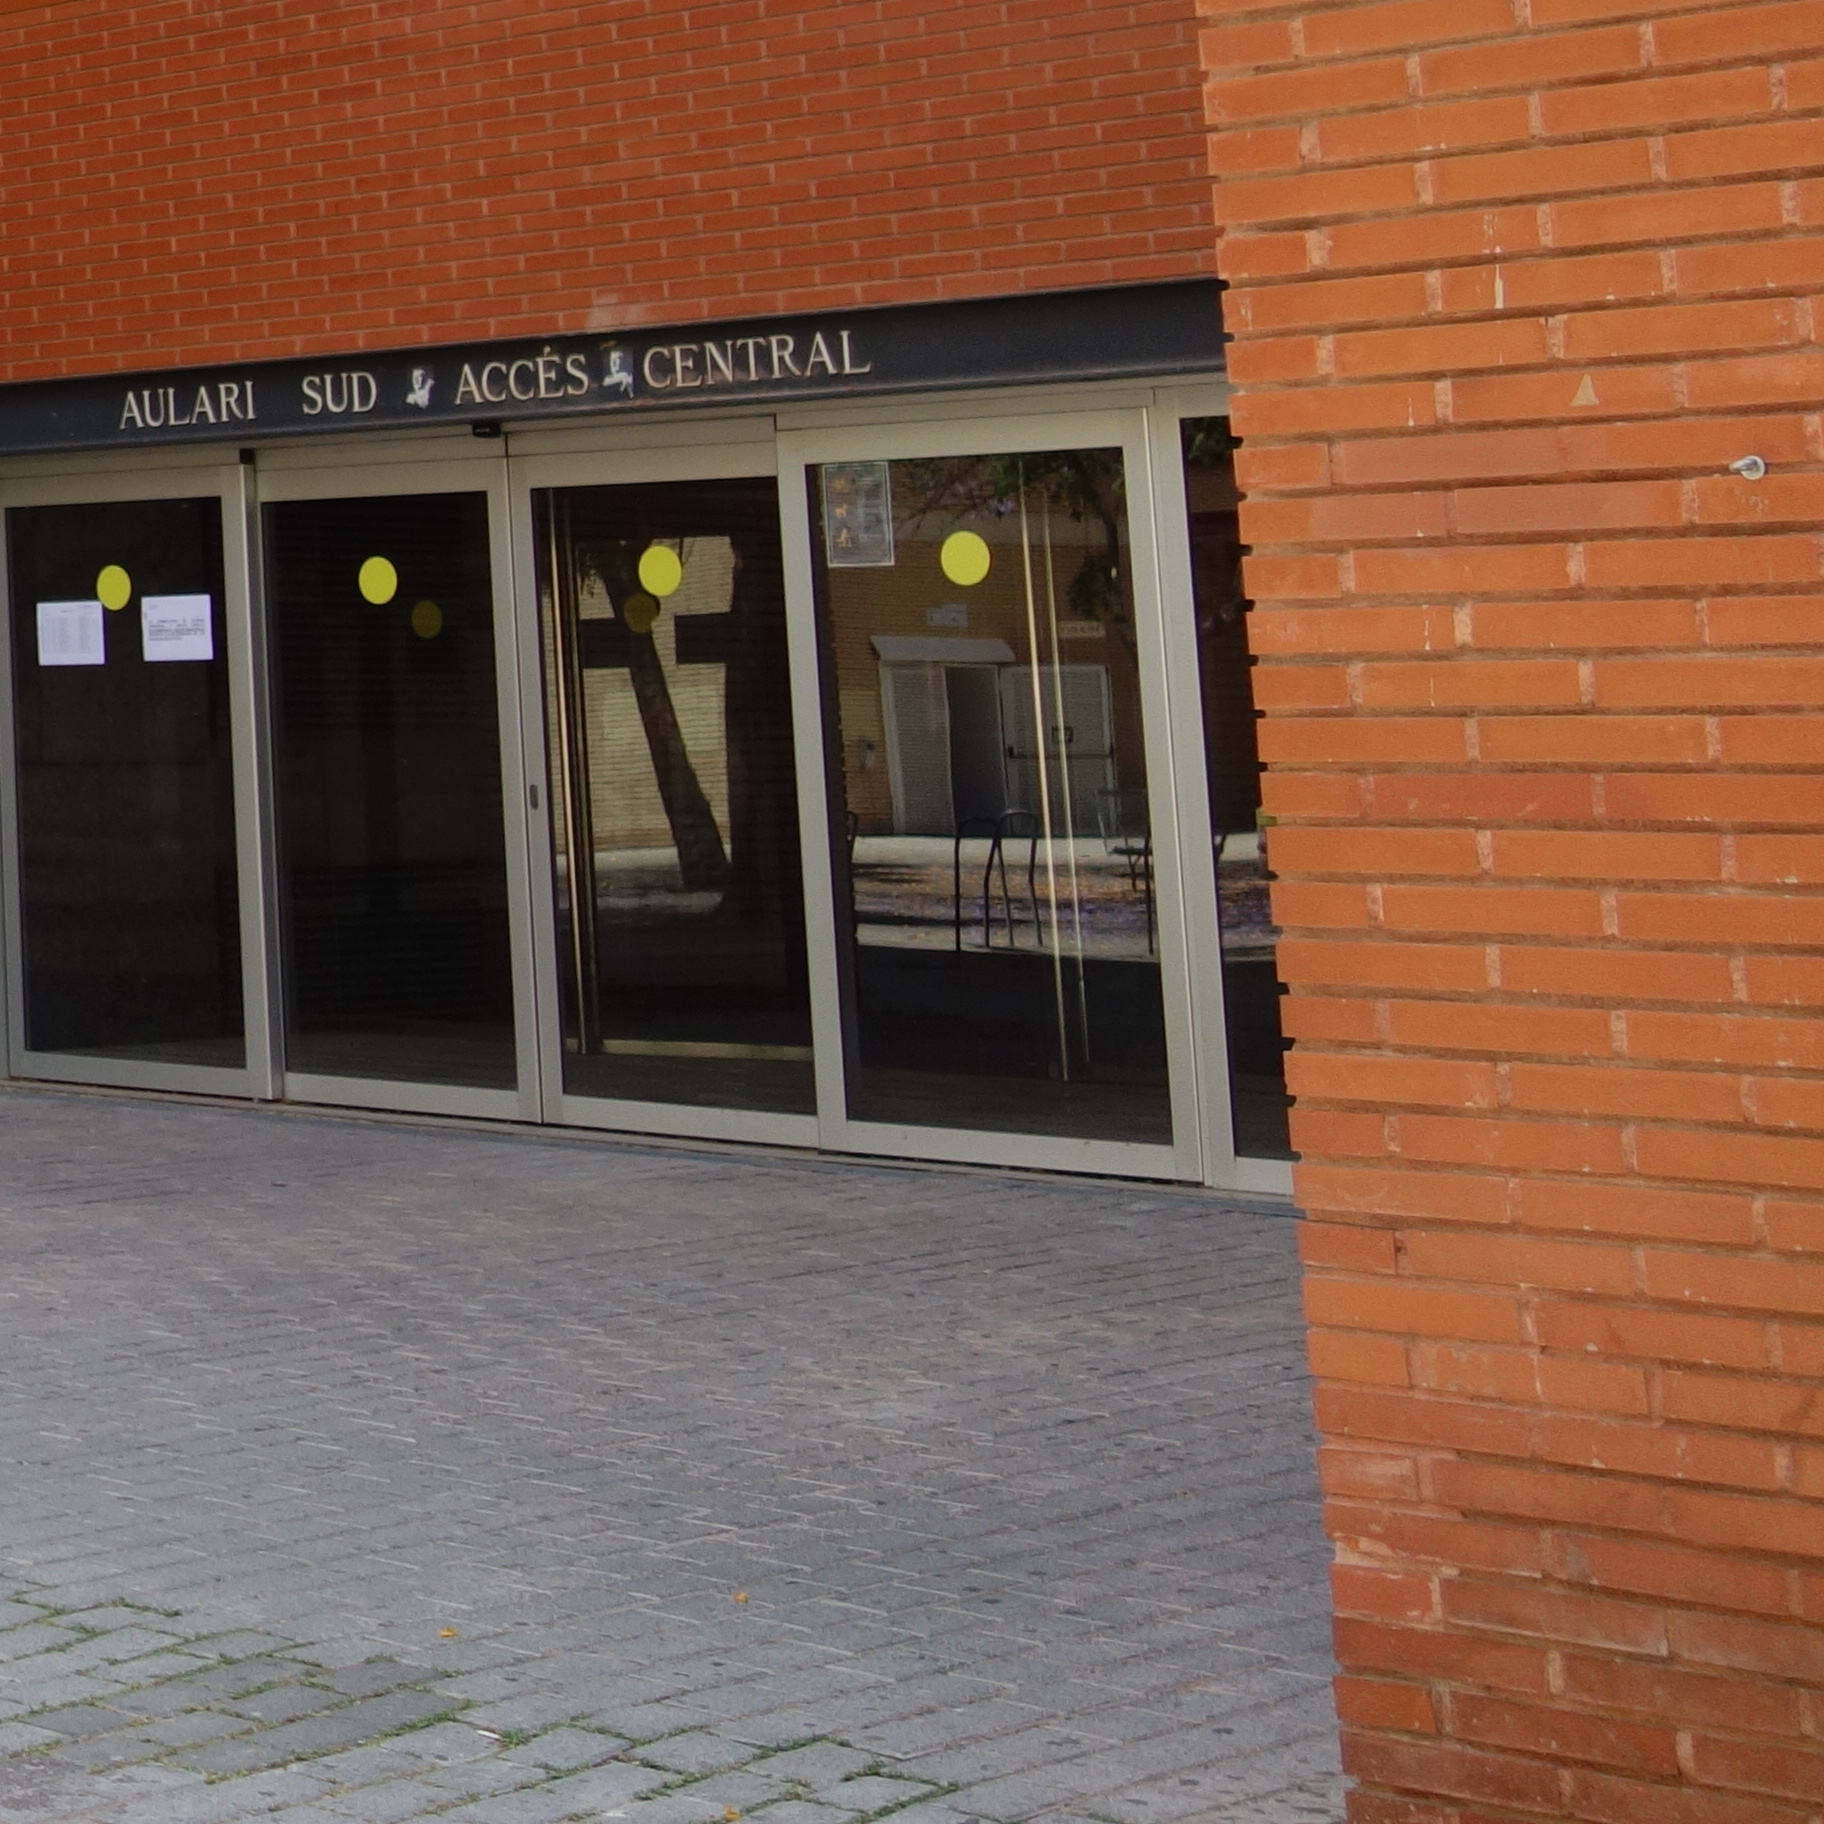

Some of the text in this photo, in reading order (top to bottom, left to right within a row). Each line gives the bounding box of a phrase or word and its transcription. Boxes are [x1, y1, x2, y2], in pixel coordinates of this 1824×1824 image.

[119, 329, 873, 430] AULARI SUD ACCÉS CENTRAL
